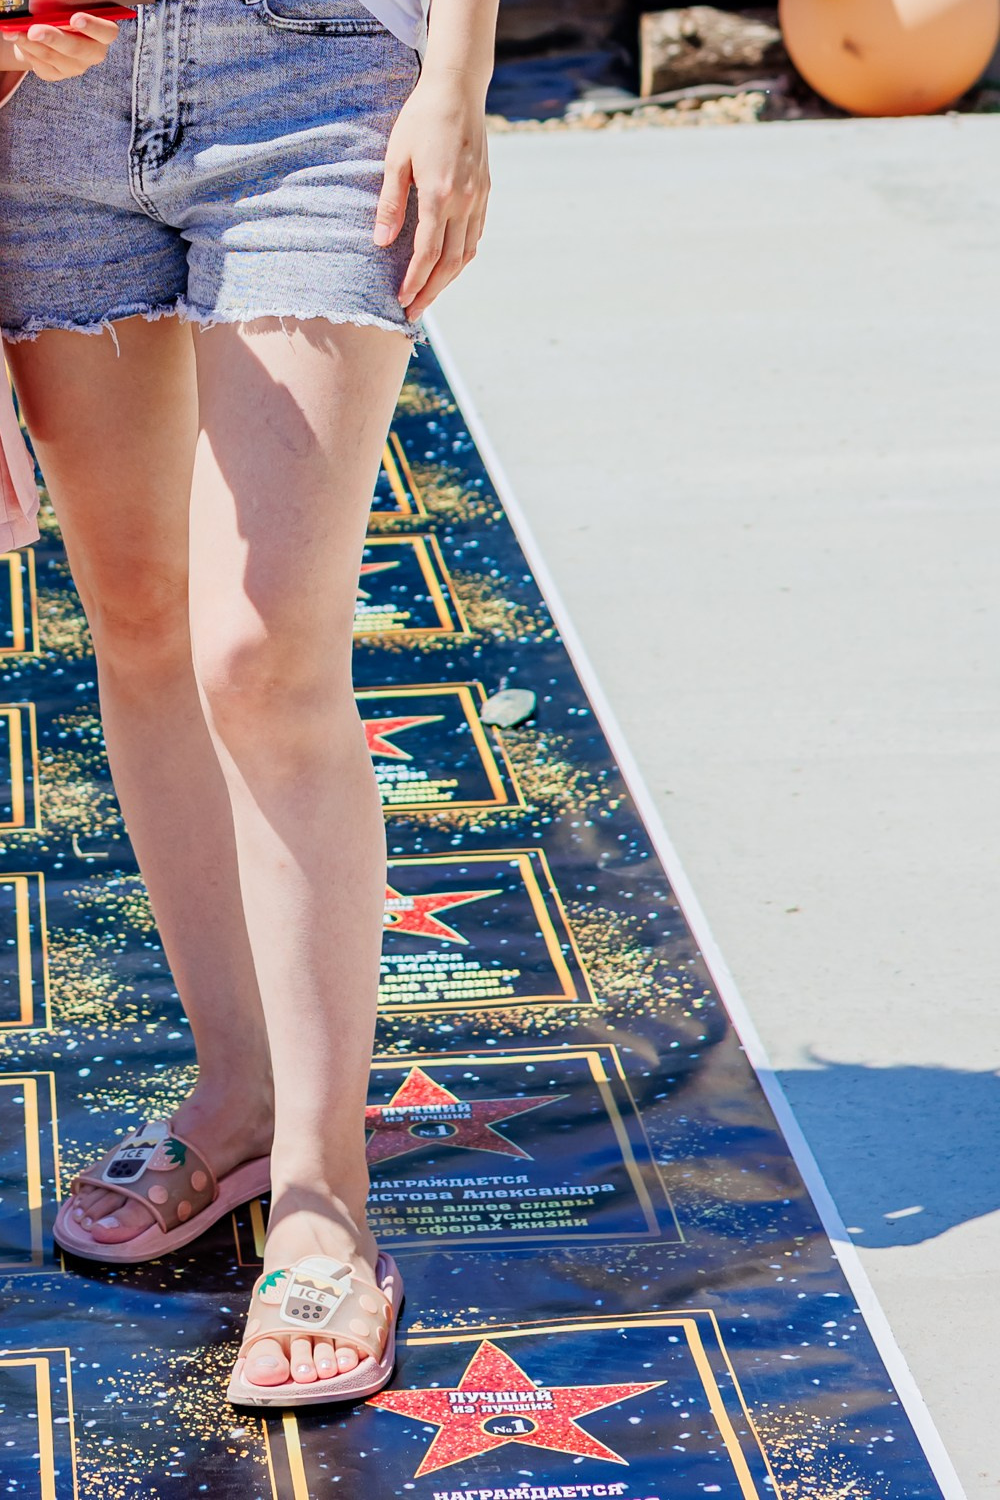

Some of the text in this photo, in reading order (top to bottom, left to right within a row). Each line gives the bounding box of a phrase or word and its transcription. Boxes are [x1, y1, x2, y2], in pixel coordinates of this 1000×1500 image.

[396, 961, 481, 973] Мария
[121, 1149, 145, 1159] ICE
[369, 1174, 529, 1189] НАГРАЖДАЕТСЯ
[462, 1183, 616, 1200] Александра
[405, 1205, 435, 1214] на
[442, 1202, 512, 1213] аллее
[519, 1198, 595, 1210] славы
[367, 1209, 572, 1227] звездные успехи
[371, 1218, 589, 1238] сех сферах жизни
[300, 1288, 326, 1303] ICE
[448, 1387, 553, 1403] ЛУЧШИЙ
[452, 1401, 553, 1414] из лучших
[432, 1482, 625, 1500] НАГРАЖДАЕТСЯ
